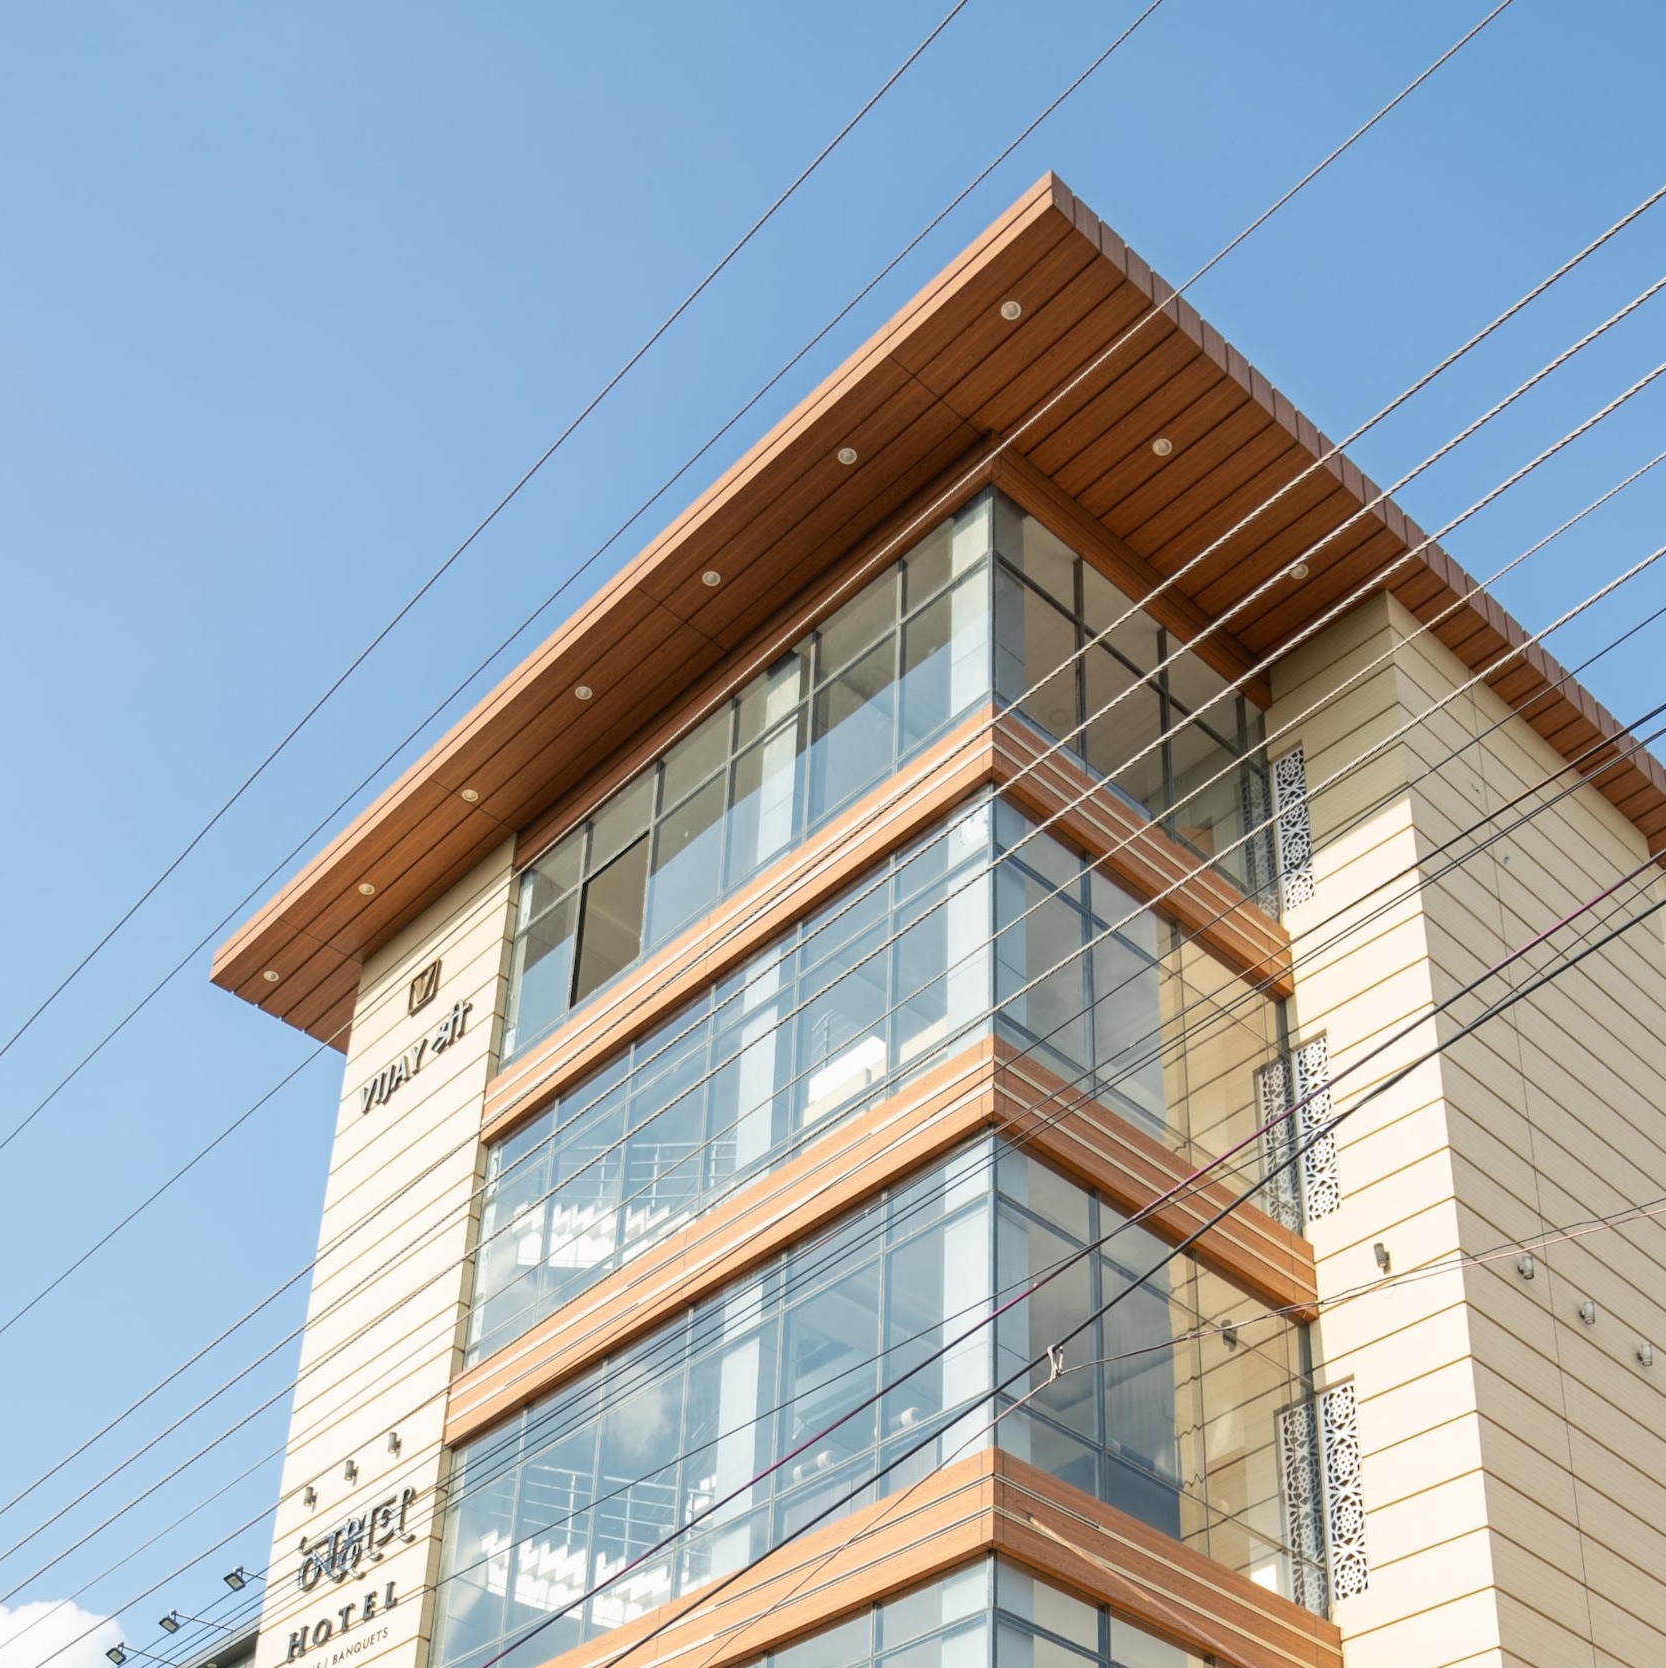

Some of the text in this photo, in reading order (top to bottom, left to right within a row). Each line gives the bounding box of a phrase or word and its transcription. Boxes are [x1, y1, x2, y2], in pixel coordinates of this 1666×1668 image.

[359, 1038, 428, 1114] VIJAY
[286, 1580, 398, 1664] HOTEL
[332, 1626, 389, 1666] BANQUETS
